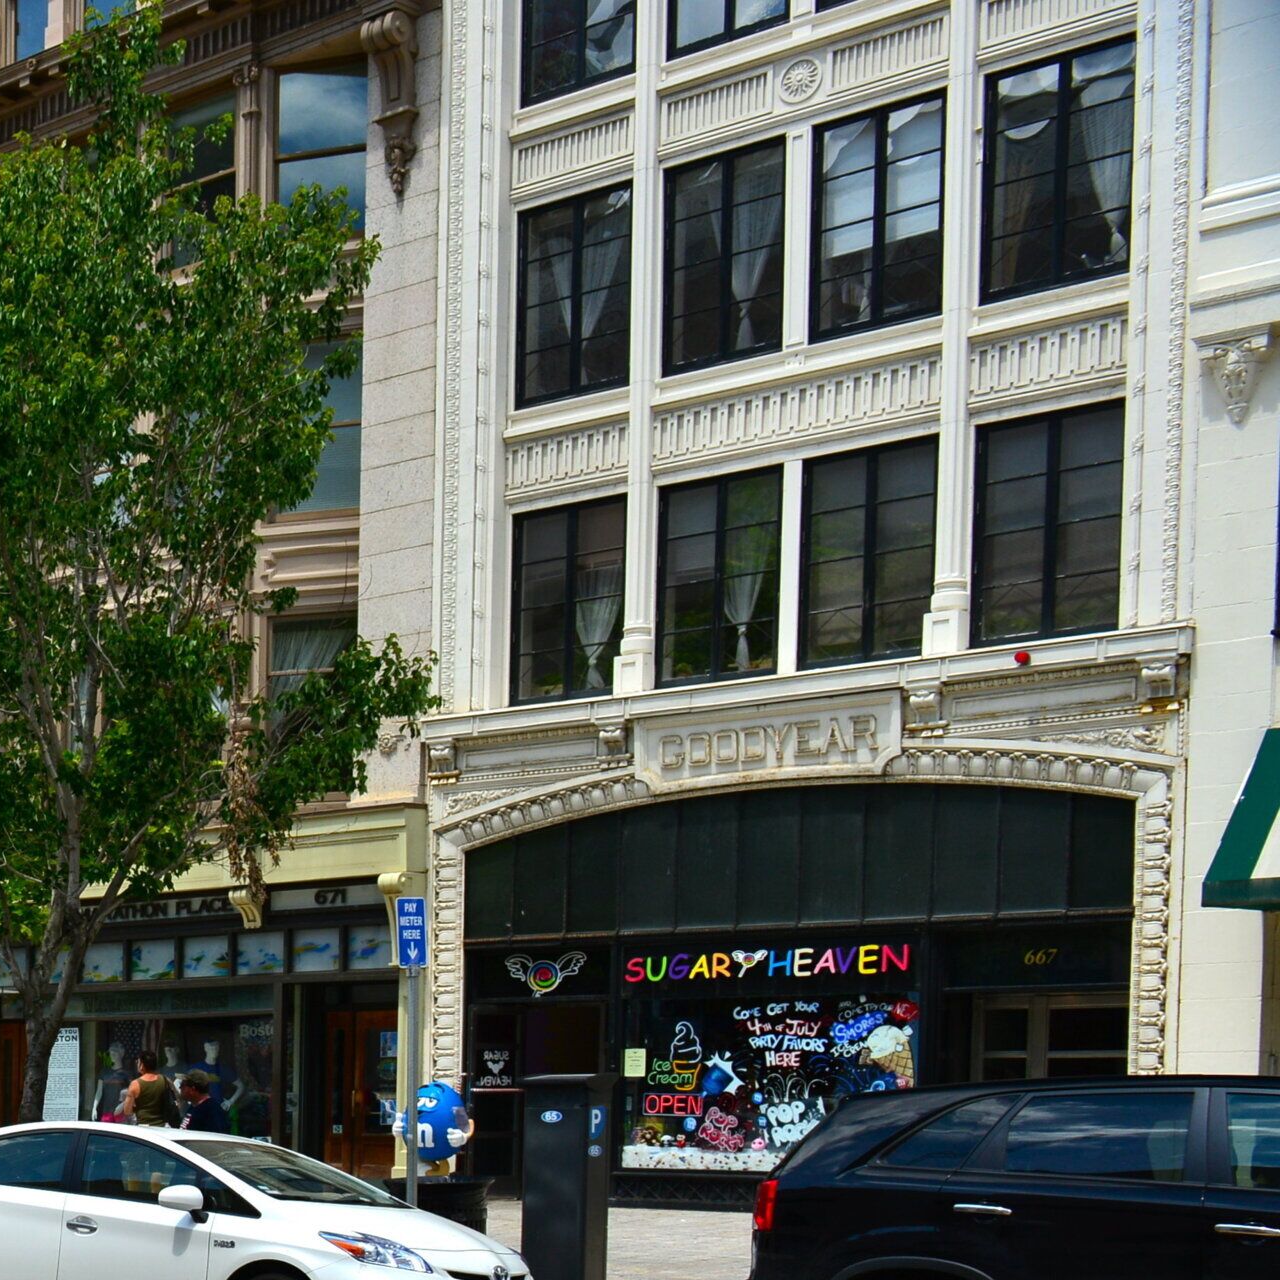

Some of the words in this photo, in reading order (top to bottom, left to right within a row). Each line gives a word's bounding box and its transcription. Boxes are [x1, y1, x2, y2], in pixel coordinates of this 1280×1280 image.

[658, 714, 879, 769] GOODYEAR
[314, 888, 347, 905] 671
[404, 902, 417, 913] PAY
[400, 916, 423, 926] METER
[403, 929, 421, 939] HERE
[624, 952, 731, 982] SUGAR
[768, 944, 910, 977] HEAVEN
[1024, 948, 1058, 965] 667
[733, 1006, 761, 1020] COME
[766, 1003, 789, 1016] GET
[794, 1000, 820, 1013] YOUR
[785, 1018, 821, 1037] JULY
[748, 1035, 781, 1049] PARTY
[782, 1035, 828, 1052] FAVORS
[652, 1058, 671, 1071] Ice
[764, 1050, 802, 1067] HERE
[647, 1073, 693, 1085] Cream
[645, 1094, 702, 1115] OPEN
[544, 1111, 558, 1121] 65
[591, 1109, 602, 1134] P
[766, 1100, 805, 1127] POP
